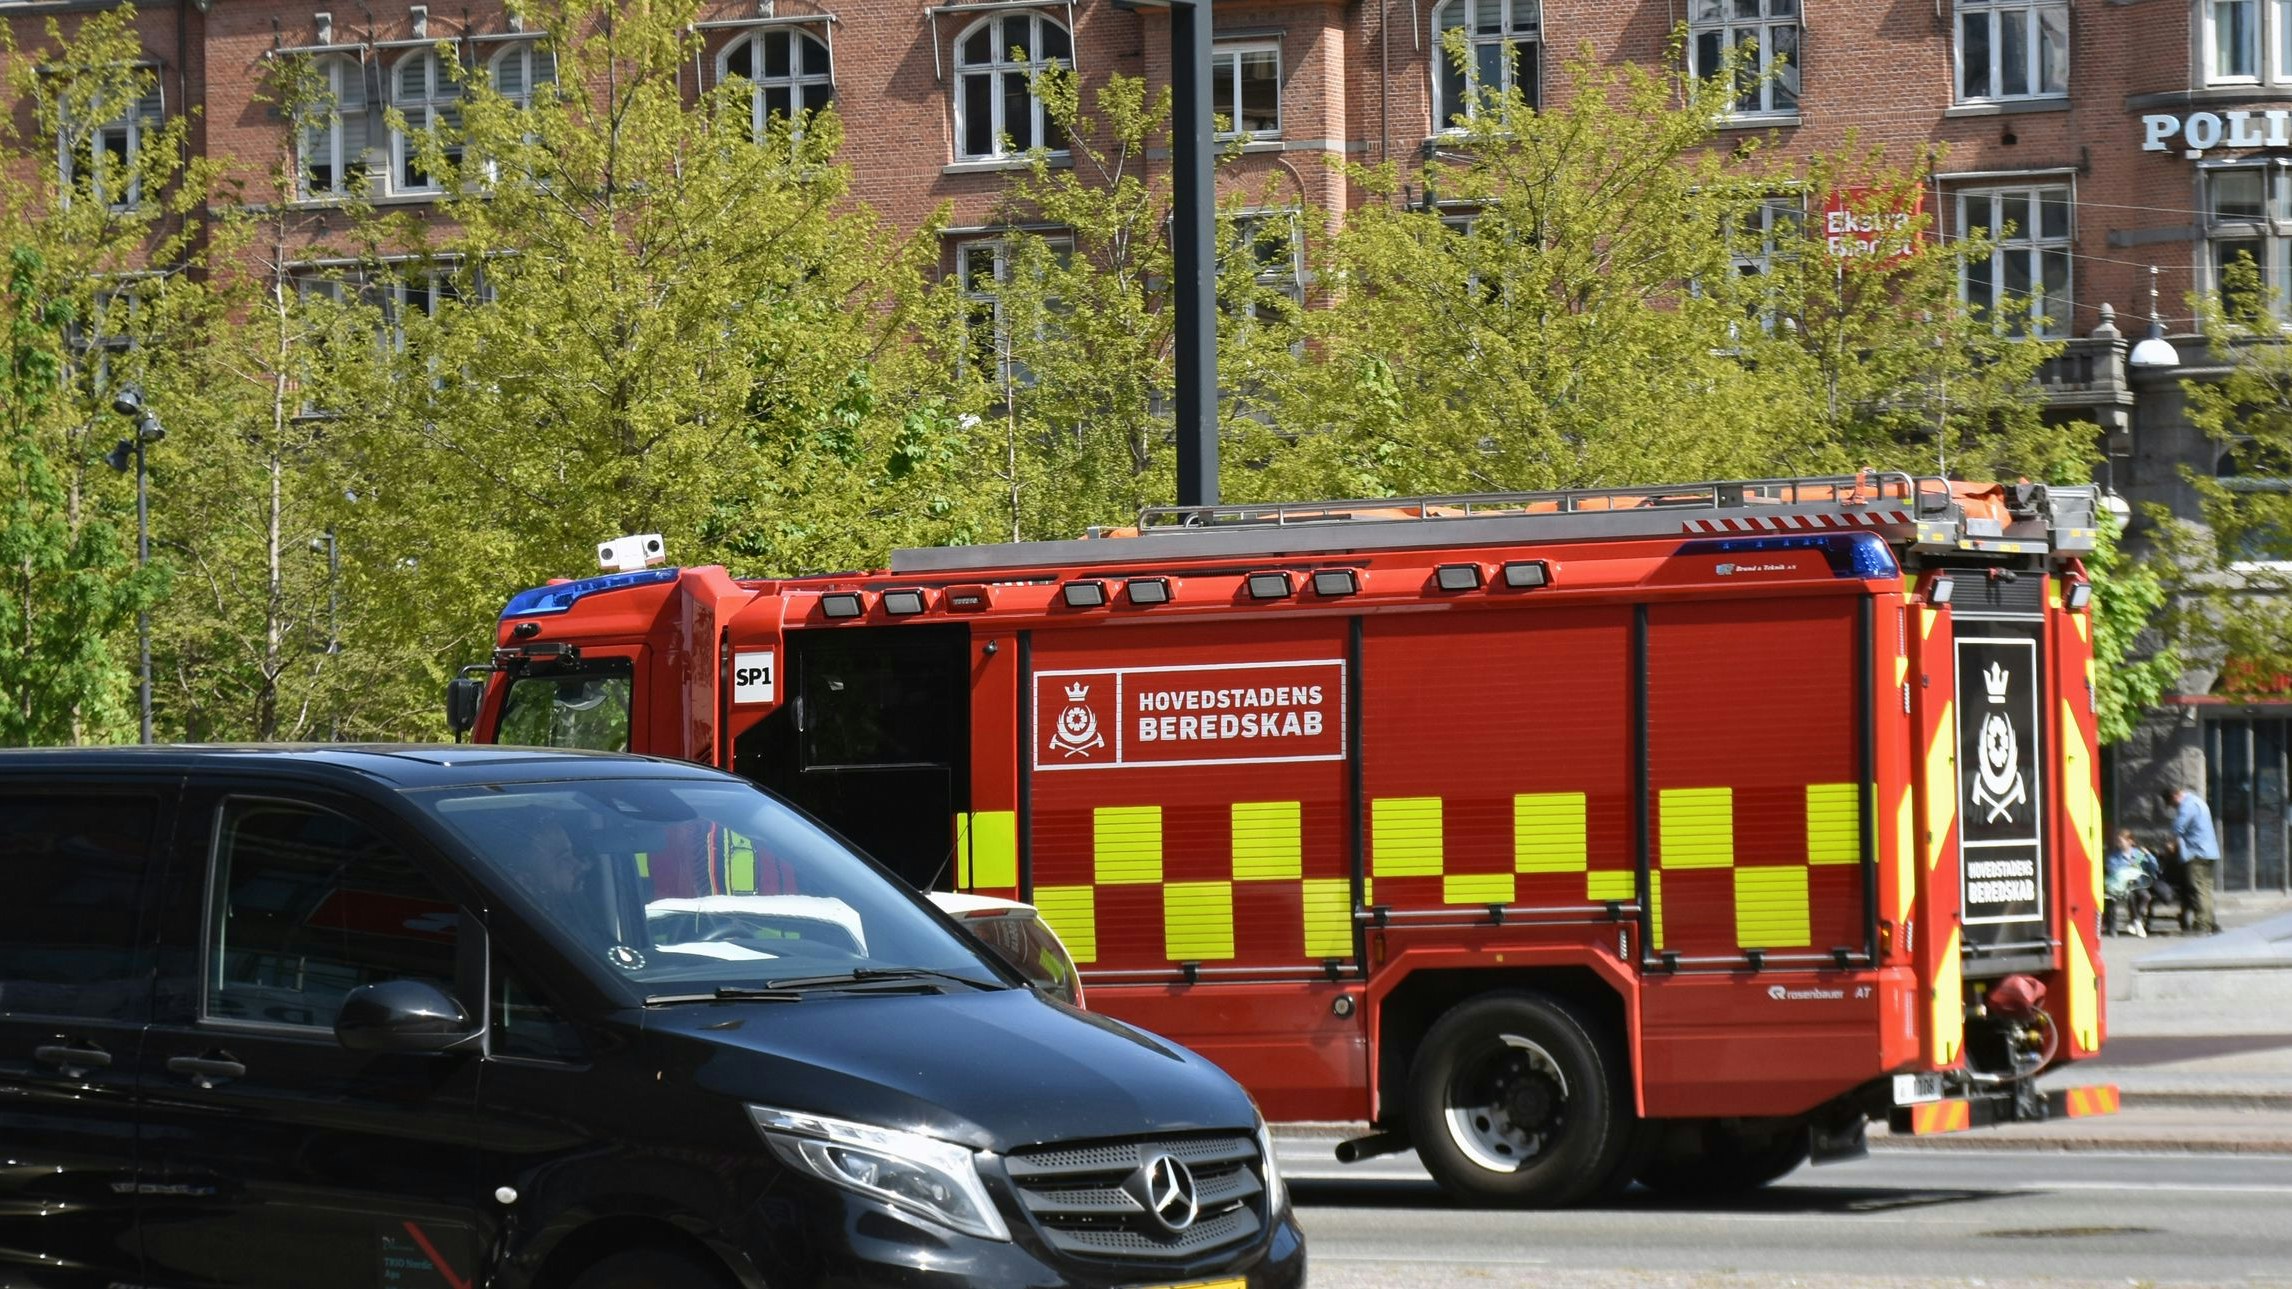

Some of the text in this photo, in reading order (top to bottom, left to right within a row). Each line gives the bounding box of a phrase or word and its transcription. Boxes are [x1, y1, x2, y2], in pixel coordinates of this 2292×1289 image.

[2142, 110, 2290, 151] POLI
[736, 667, 771, 687] SP1
[1139, 685, 1323, 711] HOVEDSTADENS
[1139, 711, 1323, 742] BEREDSKAB
[1967, 860, 2034, 879] HOVEDSTADENS
[1967, 879, 2035, 904] BEREDSKAB
[1855, 986, 1871, 999] AT
